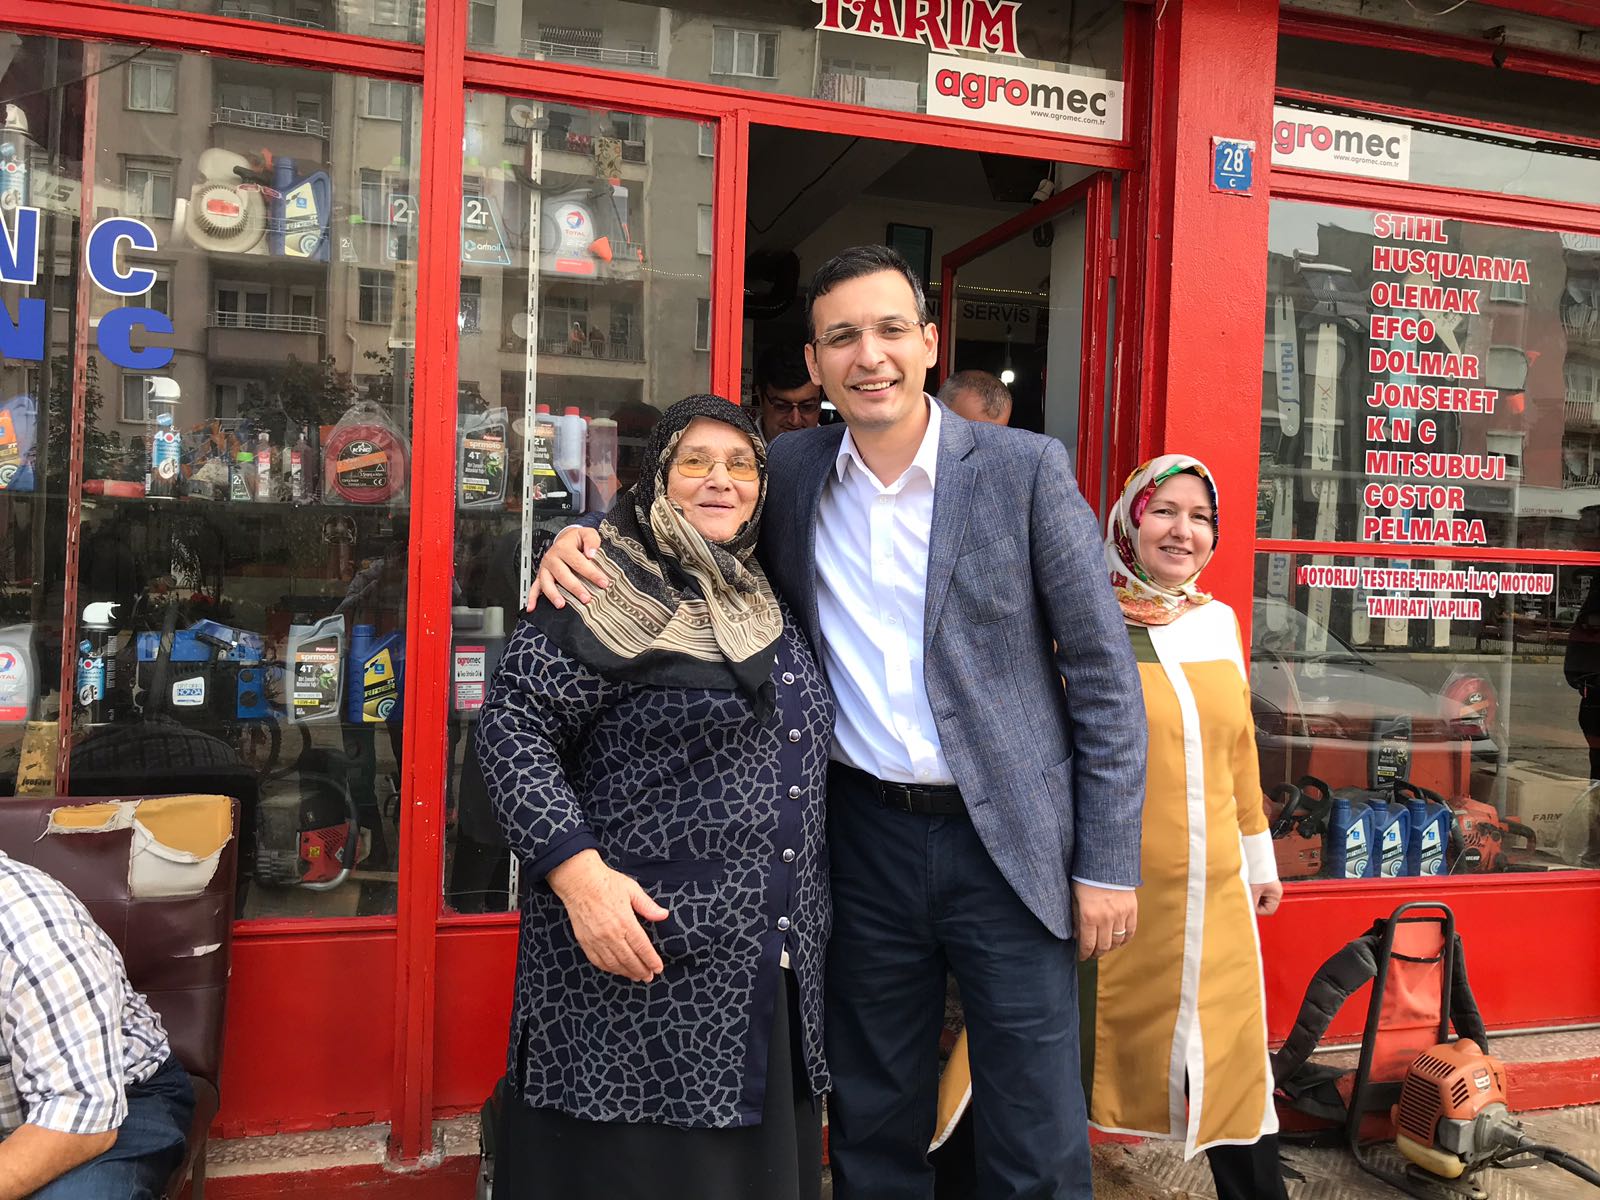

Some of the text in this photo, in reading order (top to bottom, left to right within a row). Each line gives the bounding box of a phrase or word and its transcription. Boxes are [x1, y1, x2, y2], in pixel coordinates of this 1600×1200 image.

[812, 0, 1024, 57] TARIM
[936, 68, 1107, 116] agromec
[1030, 109, 1106, 126] www.agromec.com.tr
[1274, 120, 1400, 158] gromec
[1223, 147, 1244, 173] 28
[466, 200, 489, 225] 2T
[1374, 212, 1449, 244] STIHL
[86, 217, 158, 297] C
[1371, 282, 1479, 314] OLEMAK
[97, 307, 175, 370] C
[1369, 315, 1436, 344] EFCO
[1369, 348, 1479, 379] DOLMAR
[1367, 383, 1498, 414] JONSERET
[1365, 450, 1506, 481] MITSUBUJI
[1363, 483, 1465, 511] COSTOR
[1363, 516, 1487, 544] PELMARA
[1296, 565, 1359, 588] MOTORLU
[1498, 572, 1554, 595] MOTORU
[1430, 597, 1482, 620] YAPILIR
[300, 653, 335, 662] sprmoto
[300, 664, 314, 673] 4T
